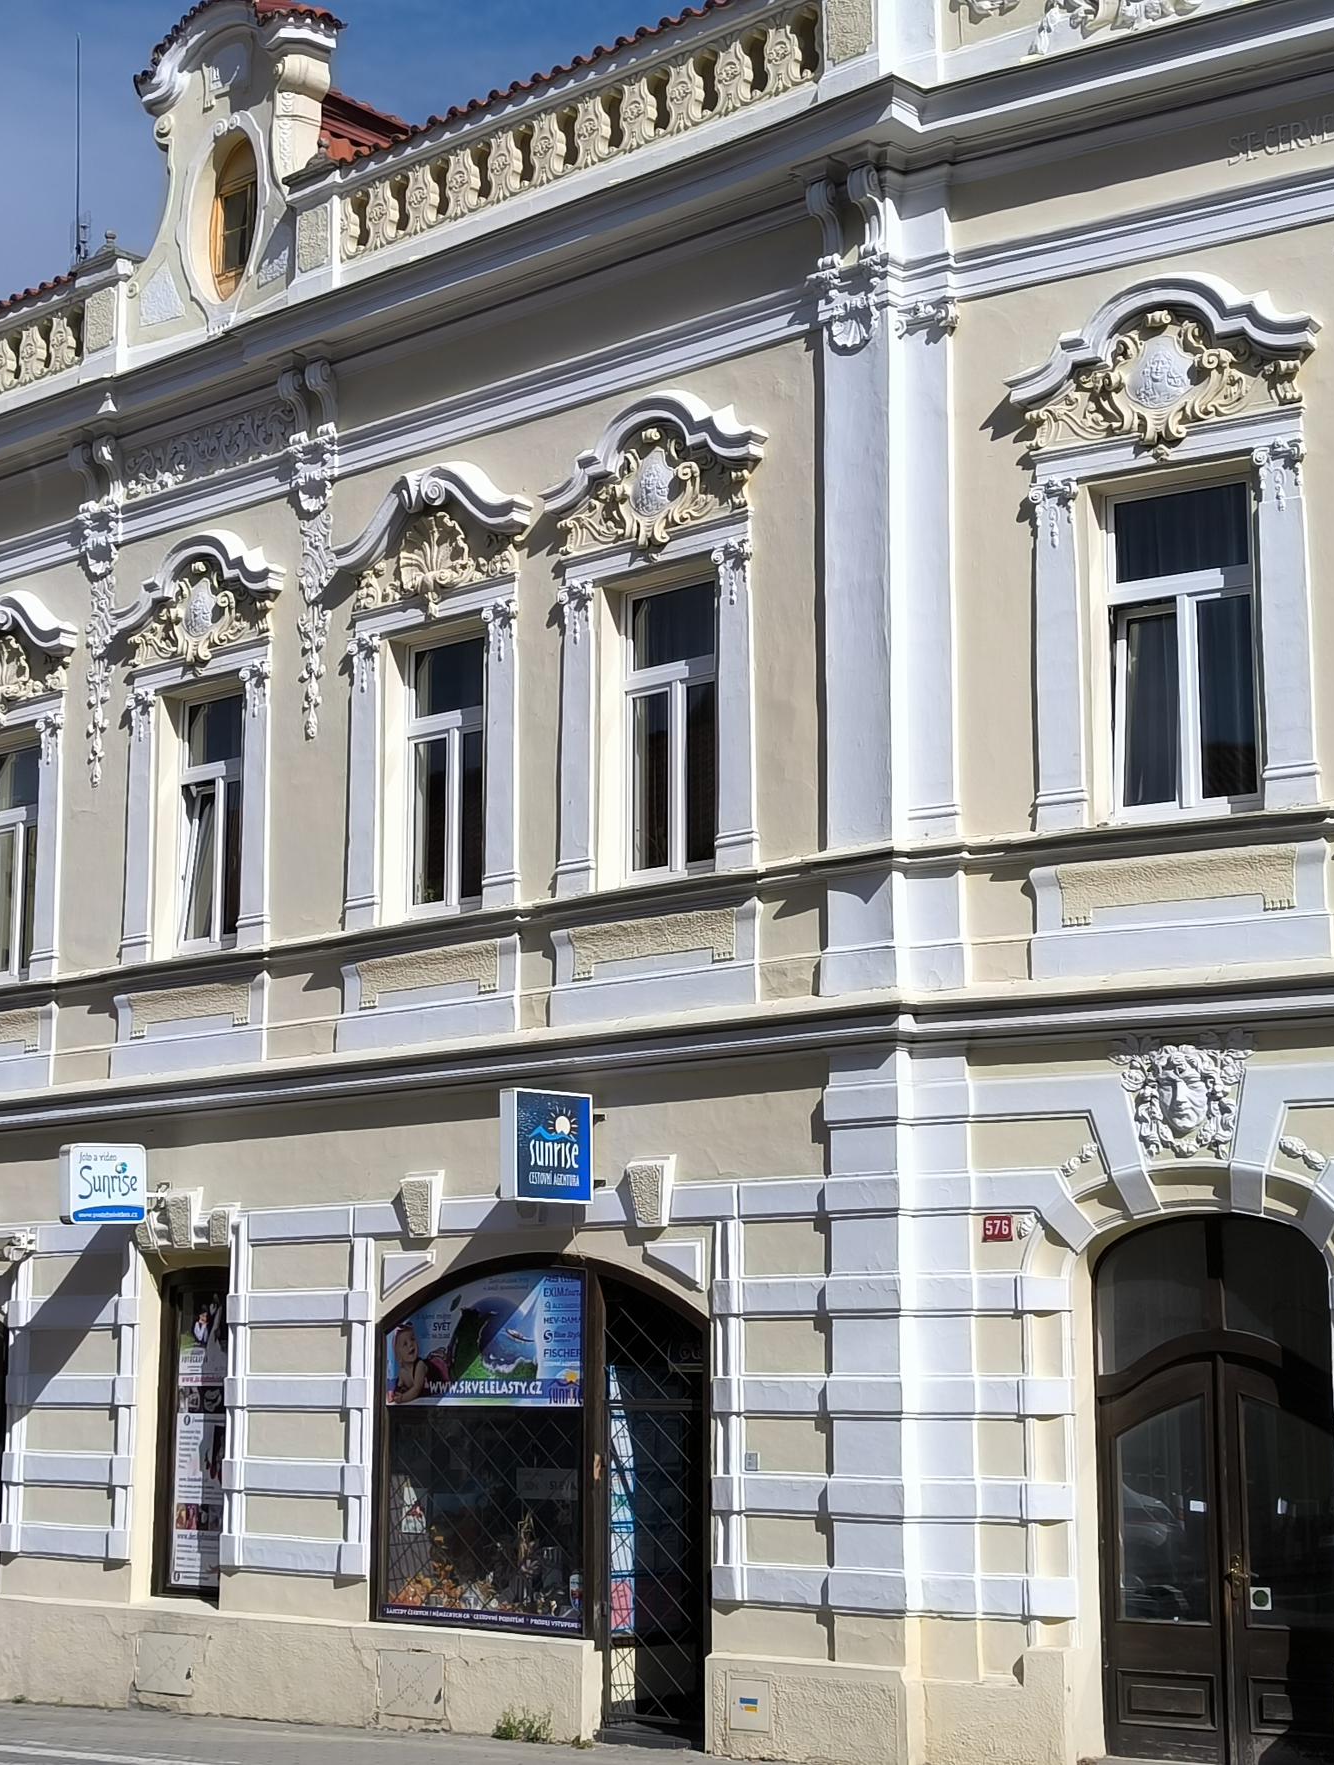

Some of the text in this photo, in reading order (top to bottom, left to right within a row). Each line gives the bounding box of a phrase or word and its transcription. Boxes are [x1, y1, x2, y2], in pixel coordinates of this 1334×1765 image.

[78, 1165, 138, 1200] Sunrise
[529, 1170, 580, 1187] CESTOVNÍ AGENTURA
[985, 1220, 1009, 1235] 576
[429, 1380, 543, 1396] WWW.SKVELELASTY.CZ
